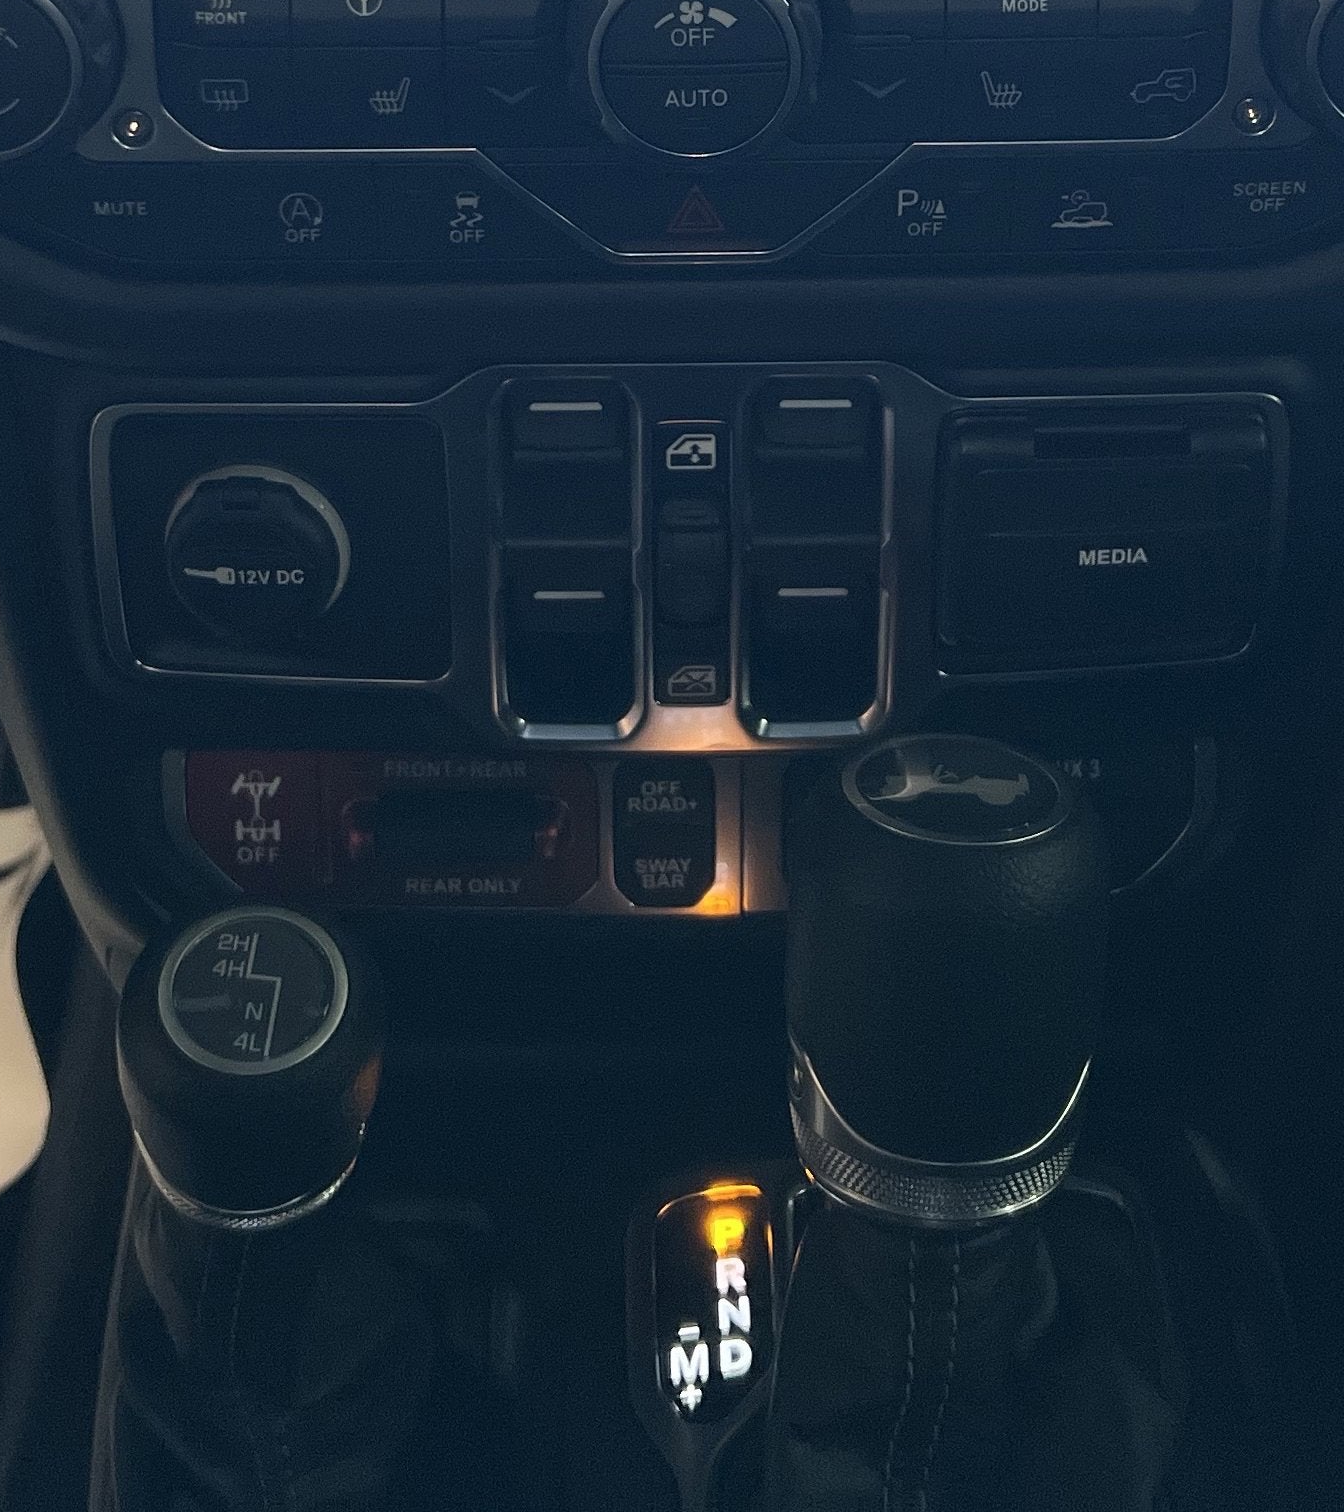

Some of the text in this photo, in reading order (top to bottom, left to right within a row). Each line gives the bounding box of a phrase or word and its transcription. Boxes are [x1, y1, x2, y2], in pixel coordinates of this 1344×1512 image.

[1002, 0, 1049, 13] MODE
[195, 10, 247, 25] FRONT
[671, 28, 716, 47] OFF
[665, 89, 728, 108] AUTO
[1233, 180, 1306, 197] SCREEN
[94, 201, 148, 216] MUTE
[897, 190, 918, 218] P
[1249, 197, 1286, 212] OFF
[284, 228, 322, 243] OFF
[449, 228, 485, 243] OFF
[907, 222, 944, 236] OFF
[1078, 547, 1148, 566] MEDIA
[237, 569, 305, 585] 12V DC
[1088, 757, 1101, 779] 3
[640, 780, 682, 796] OFF
[237, 848, 280, 864] OFF
[633, 857, 692, 874] SWAY
[405, 877, 522, 894] REAR ONLY
[217, 933, 250, 953] 2H
[212, 960, 247, 979] 4H
[245, 1002, 264, 1021] N
[233, 1034, 261, 1054] 4L
[713, 1217, 745, 1255] P
[716, 1257, 747, 1294] R
[718, 1294, 751, 1333] N
[670, 1340, 709, 1387] M
[719, 1337, 753, 1379] D
